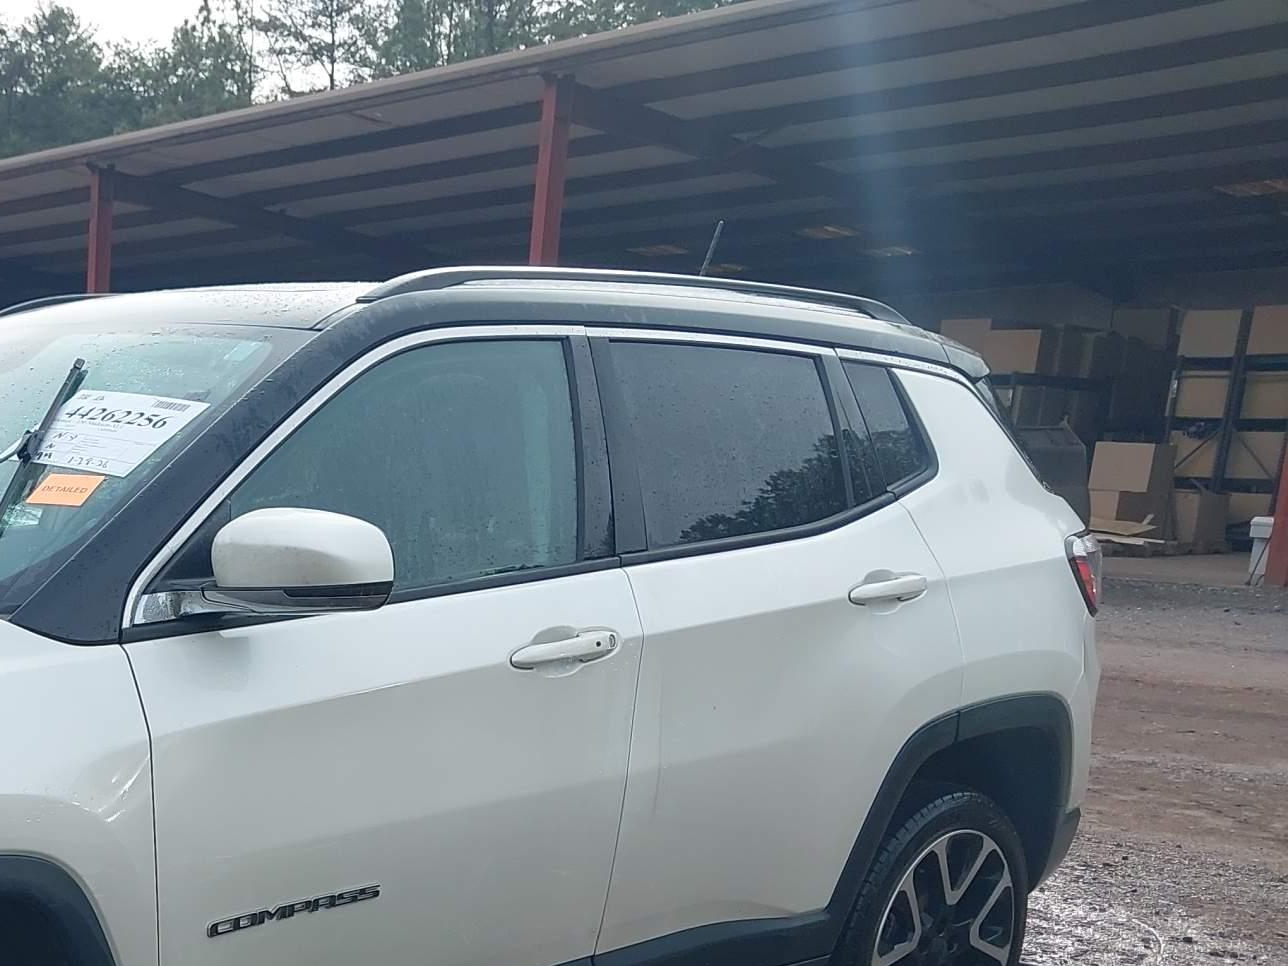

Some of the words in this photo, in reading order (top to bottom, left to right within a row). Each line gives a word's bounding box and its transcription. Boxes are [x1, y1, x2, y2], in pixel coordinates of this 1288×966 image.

[65, 405, 175, 430] 44262256
[40, 484, 90, 495] DETAILED
[207, 883, 381, 938] COMPASS
